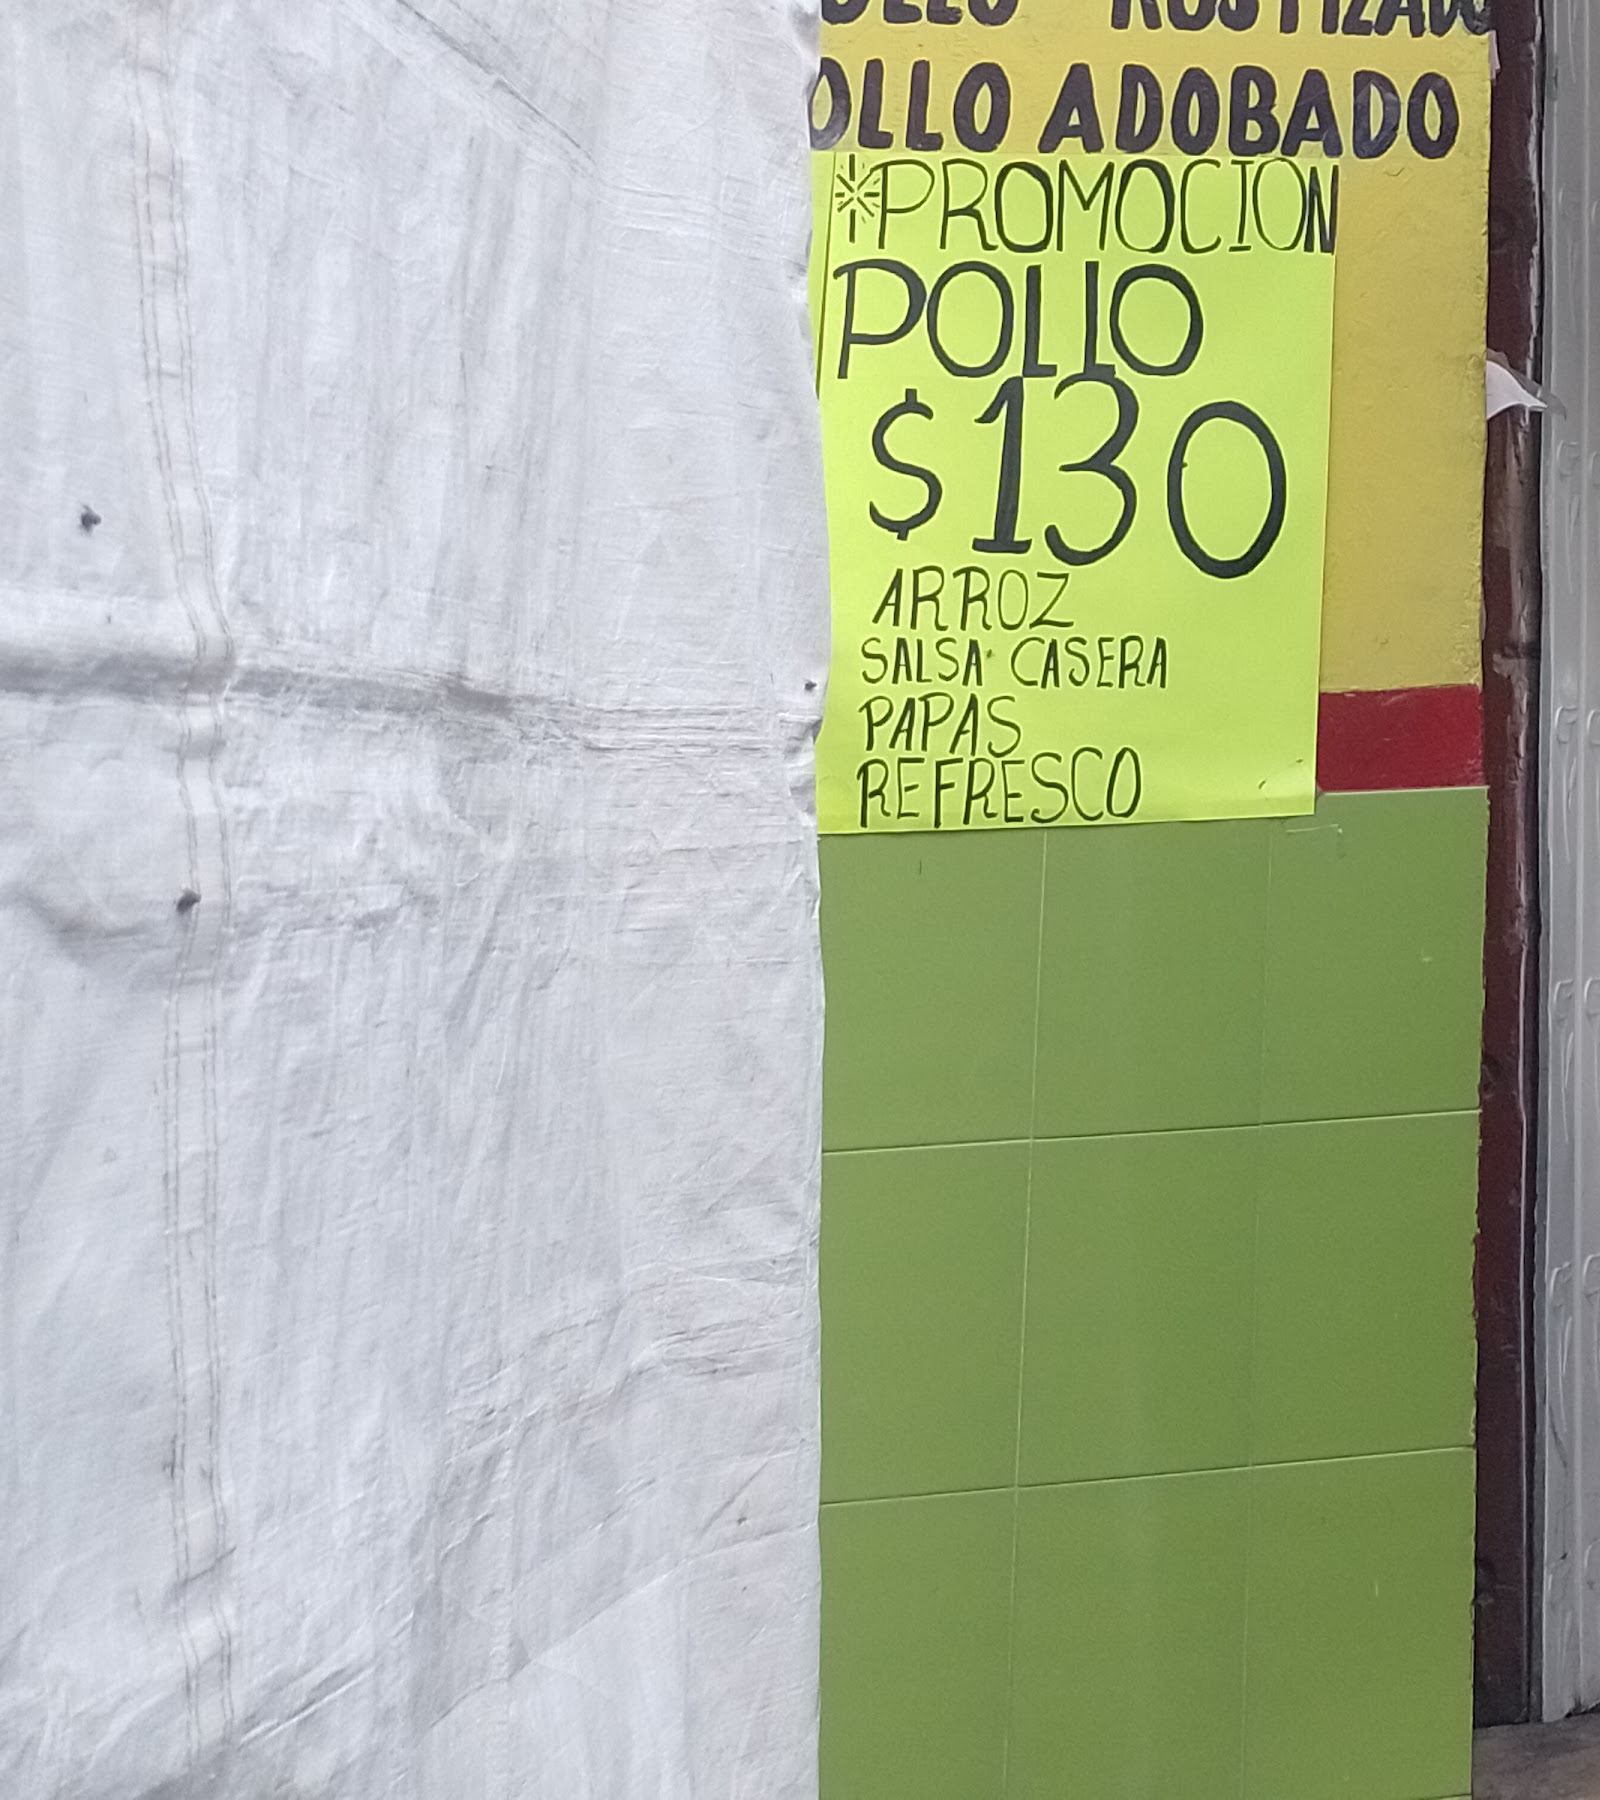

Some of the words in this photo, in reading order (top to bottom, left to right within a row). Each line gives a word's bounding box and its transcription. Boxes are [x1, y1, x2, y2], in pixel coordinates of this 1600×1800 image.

[809, 57, 1011, 153] OLLO
[1038, 63, 1460, 159] ADOBADO
[832, 258, 1204, 380] POLLO
[871, 565, 1075, 632] ARROZ
[860, 637, 985, 687] SALSA
[1010, 636, 1168, 690] CASERA
[858, 693, 1022, 758] PAPAS
[856, 746, 1143, 828] REFRESCO
